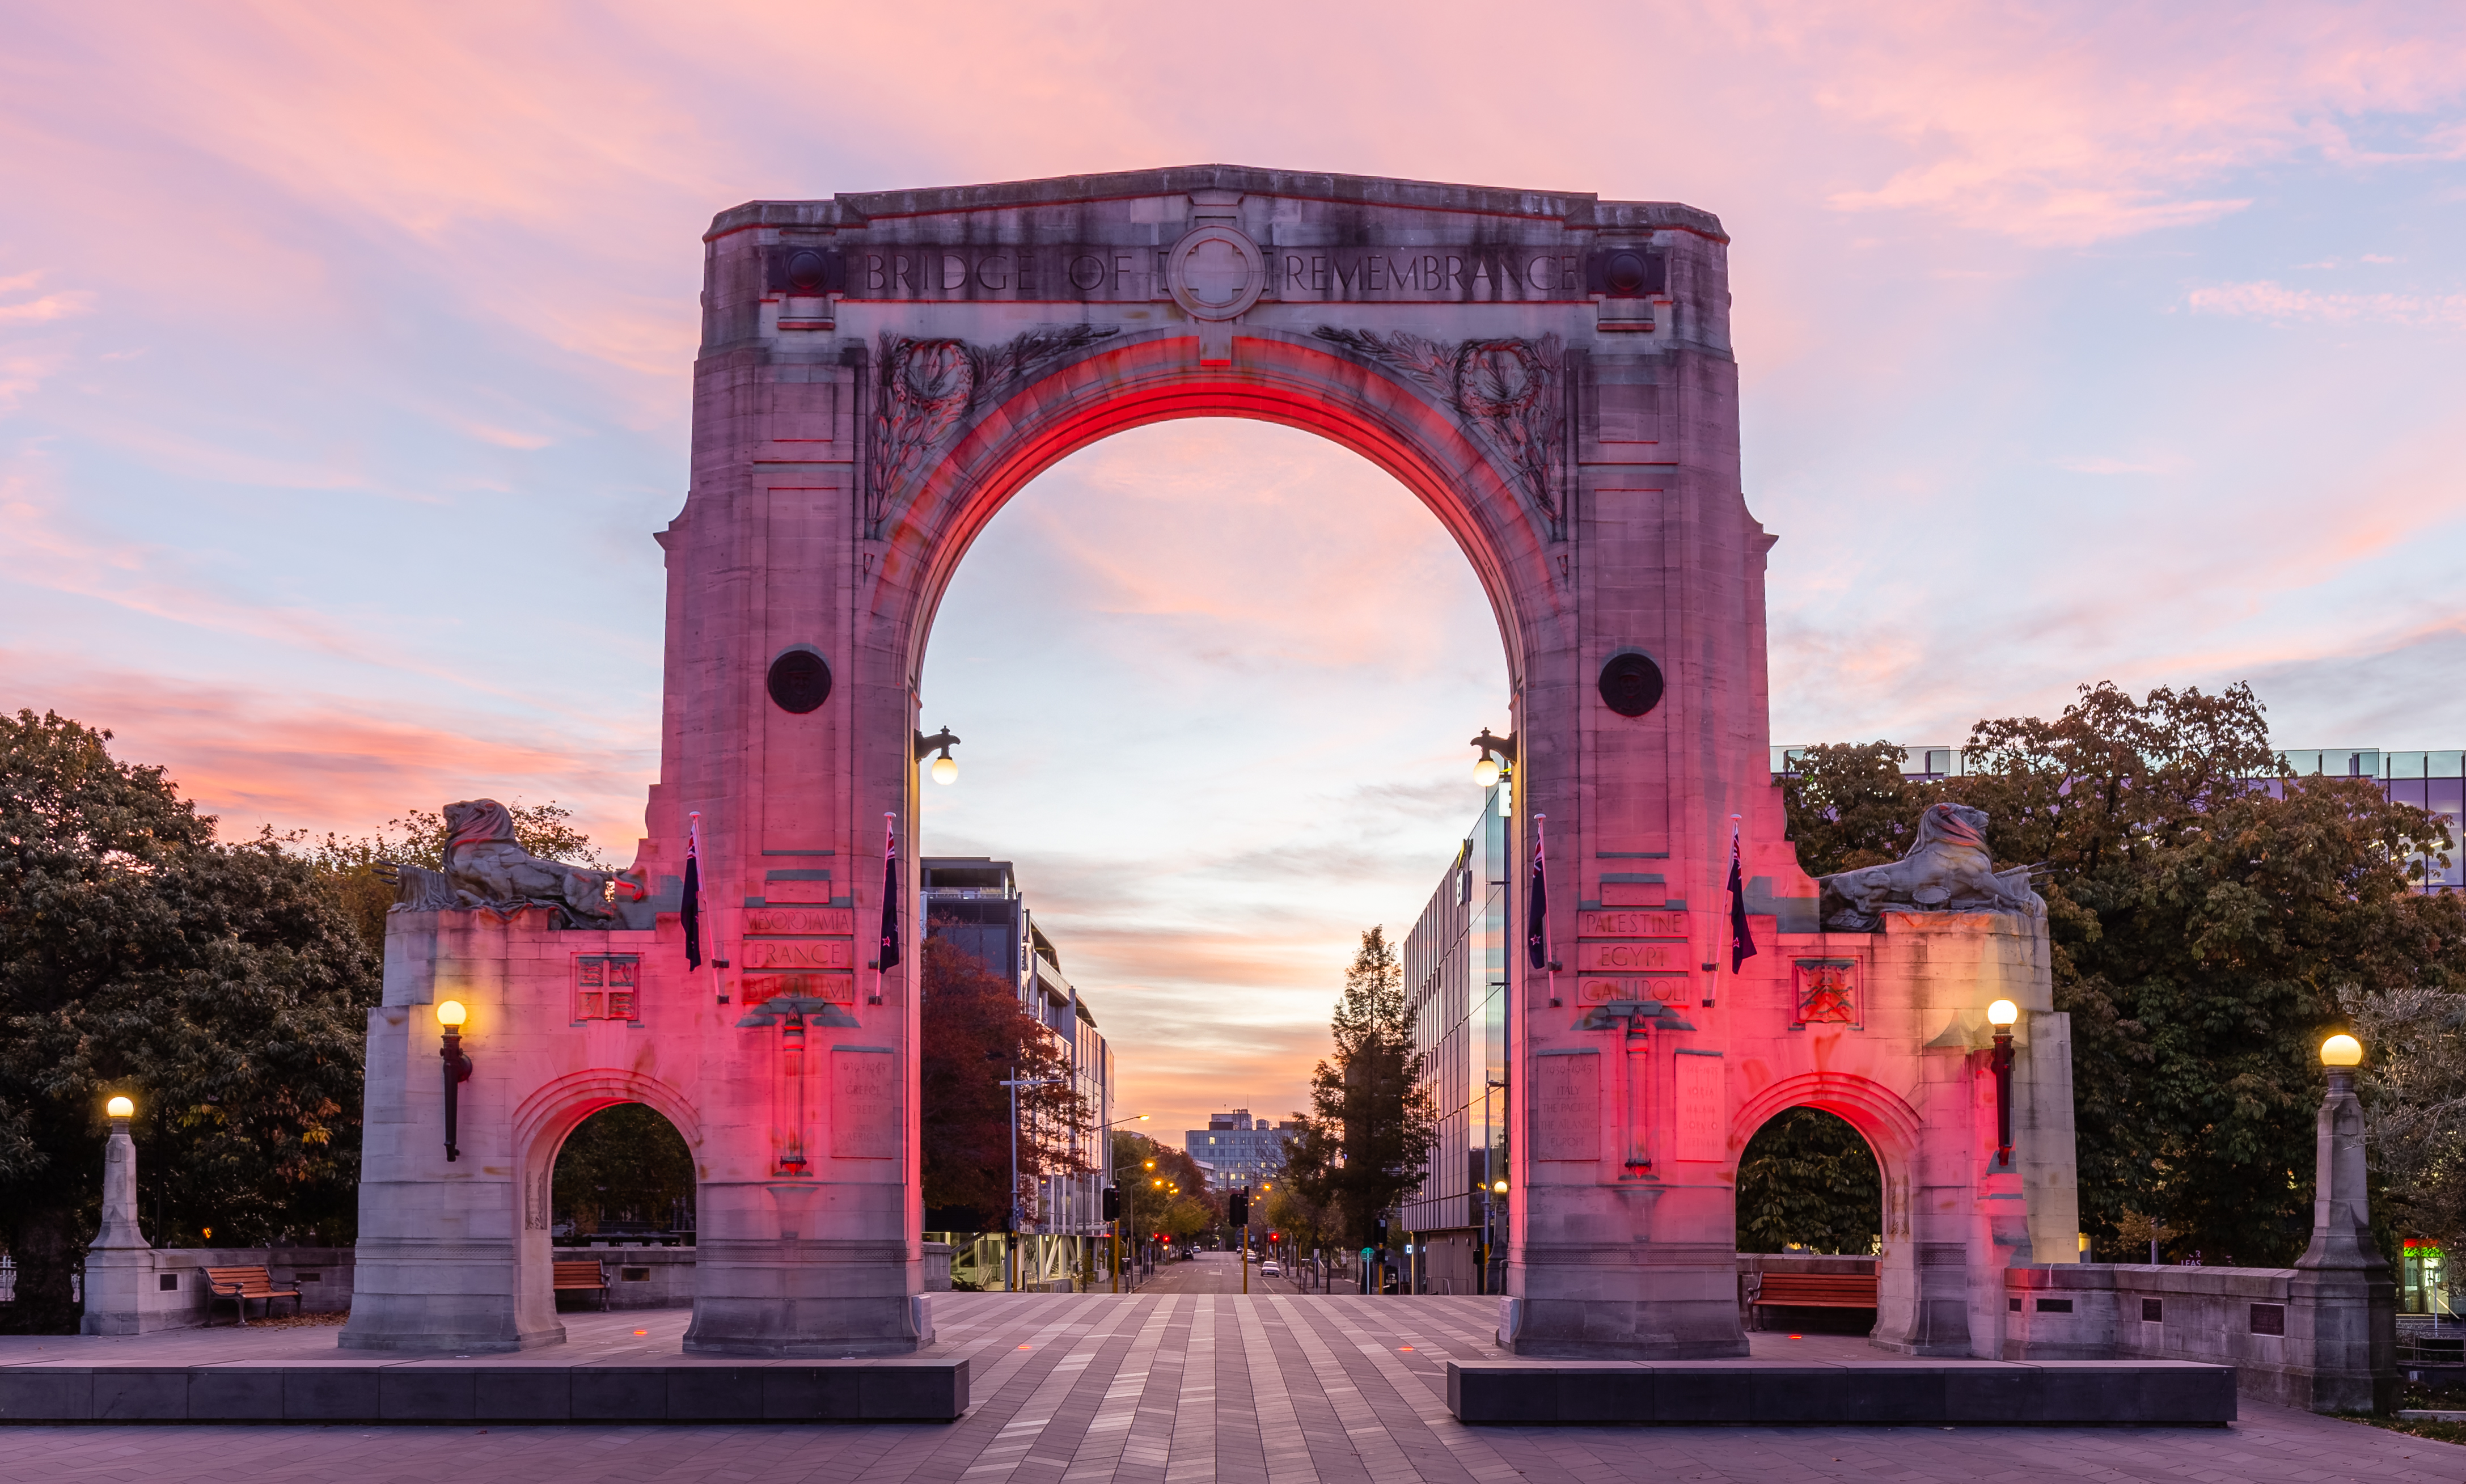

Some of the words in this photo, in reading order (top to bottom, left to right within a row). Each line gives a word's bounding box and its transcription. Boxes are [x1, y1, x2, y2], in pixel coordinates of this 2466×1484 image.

[866, 255, 1035, 291] BRIDGE
[1068, 255, 1132, 291] OF
[1285, 255, 1576, 291] REMEMBRANCE
[745, 911, 849, 930] MESOPOTAMIA
[1586, 914, 1681, 933] PALESTINE
[754, 944, 840, 964] FRANCE
[1601, 946, 1667, 966] EGYPT
[748, 977, 845, 999] BELGIUM
[1583, 980, 1686, 1001] GALLIPOLI
[1546, 1064, 1592, 1076] 1939-1945
[845, 1085, 881, 1096] GREECE
[1556, 1085, 1581, 1096] ITALY
[849, 1105, 878, 1115] CRETE
[1542, 1104, 1557, 1113] THE
[1561, 1102, 1596, 1113] PACIFIC
[1541, 1121, 1555, 1130] THE
[1558, 1118, 1598, 1130] ATLANTIC
[847, 1132, 881, 1142] AFRICA
[1551, 1136, 1585, 1147] EUROPE
